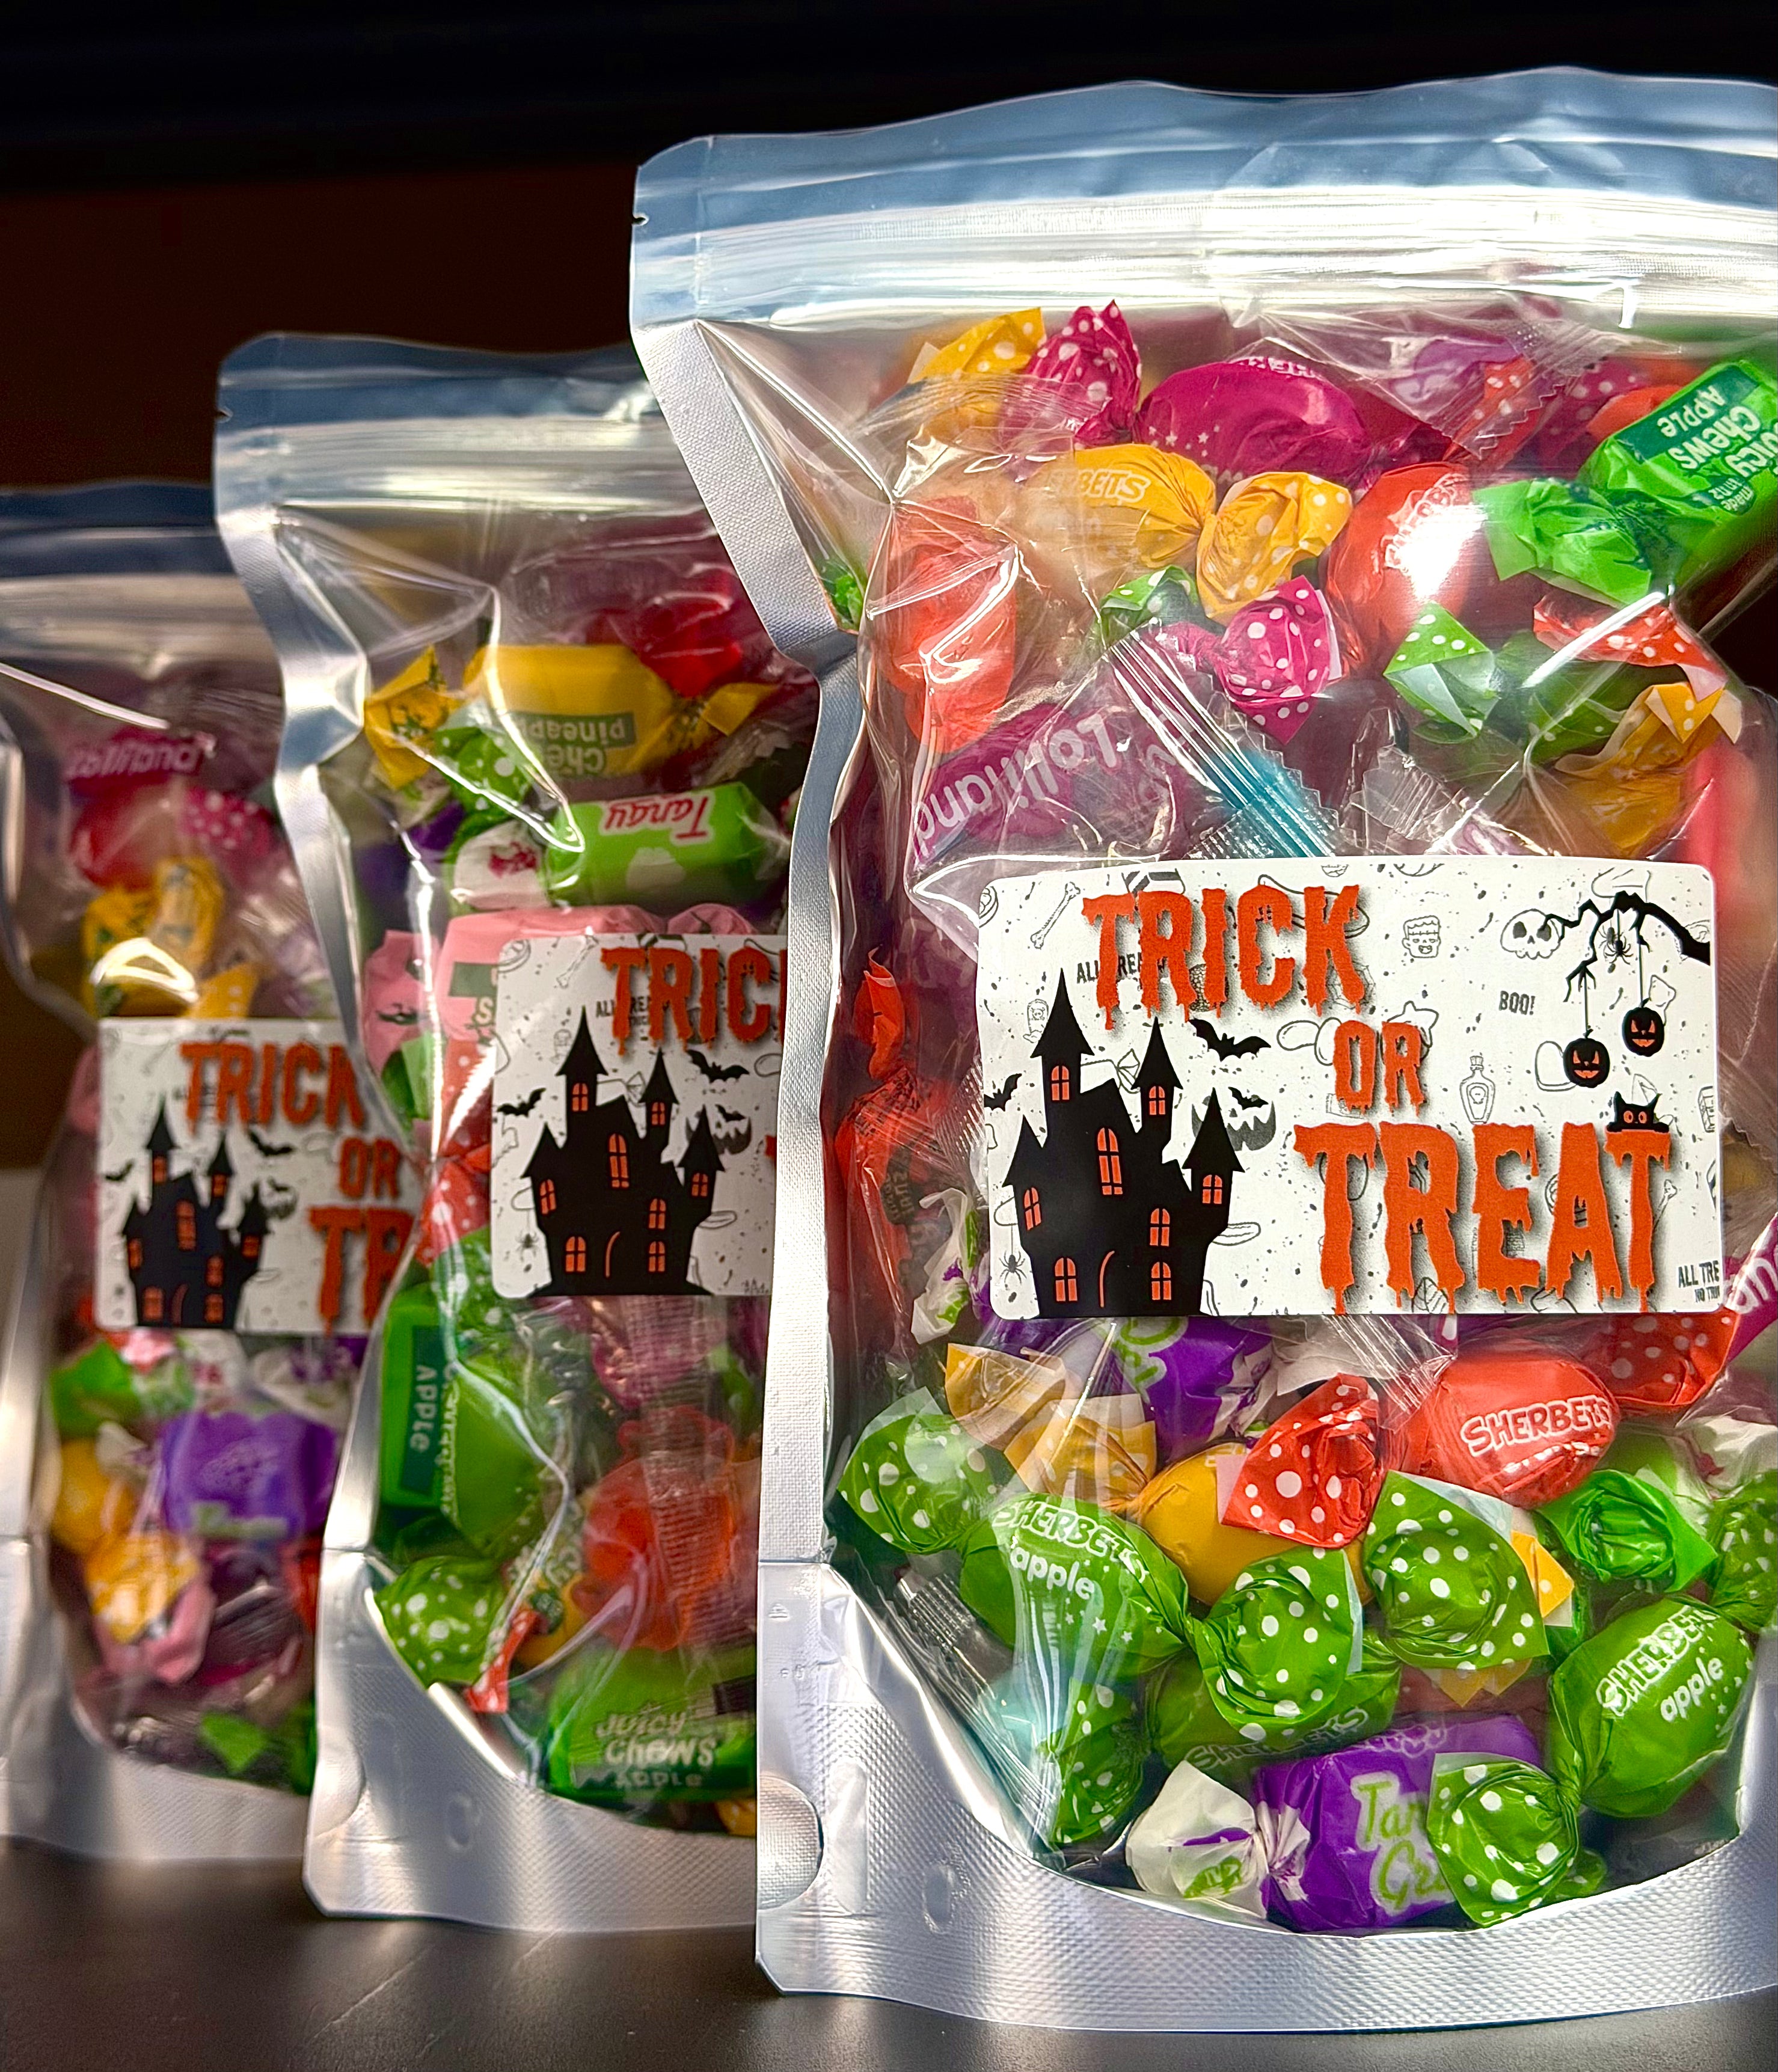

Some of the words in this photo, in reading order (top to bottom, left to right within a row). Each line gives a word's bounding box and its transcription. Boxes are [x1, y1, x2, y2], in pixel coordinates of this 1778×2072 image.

[547, 745, 605, 775] Che
[604, 794, 710, 840] Tangy
[1081, 883, 1370, 1031] TRICK
[601, 946, 788, 1056] TRIC
[1498, 990, 1536, 1015] BOO!
[1332, 1020, 1425, 1116] OR
[339, 1136, 402, 1200] OR
[1293, 1120, 1673, 1315] TREAT
[1678, 1264, 1699, 1288] ALL
[1460, 1394, 1612, 1457] SHERBETS
[1010, 1546, 1096, 1600] apple
[1660, 1657, 1724, 1723] apple
